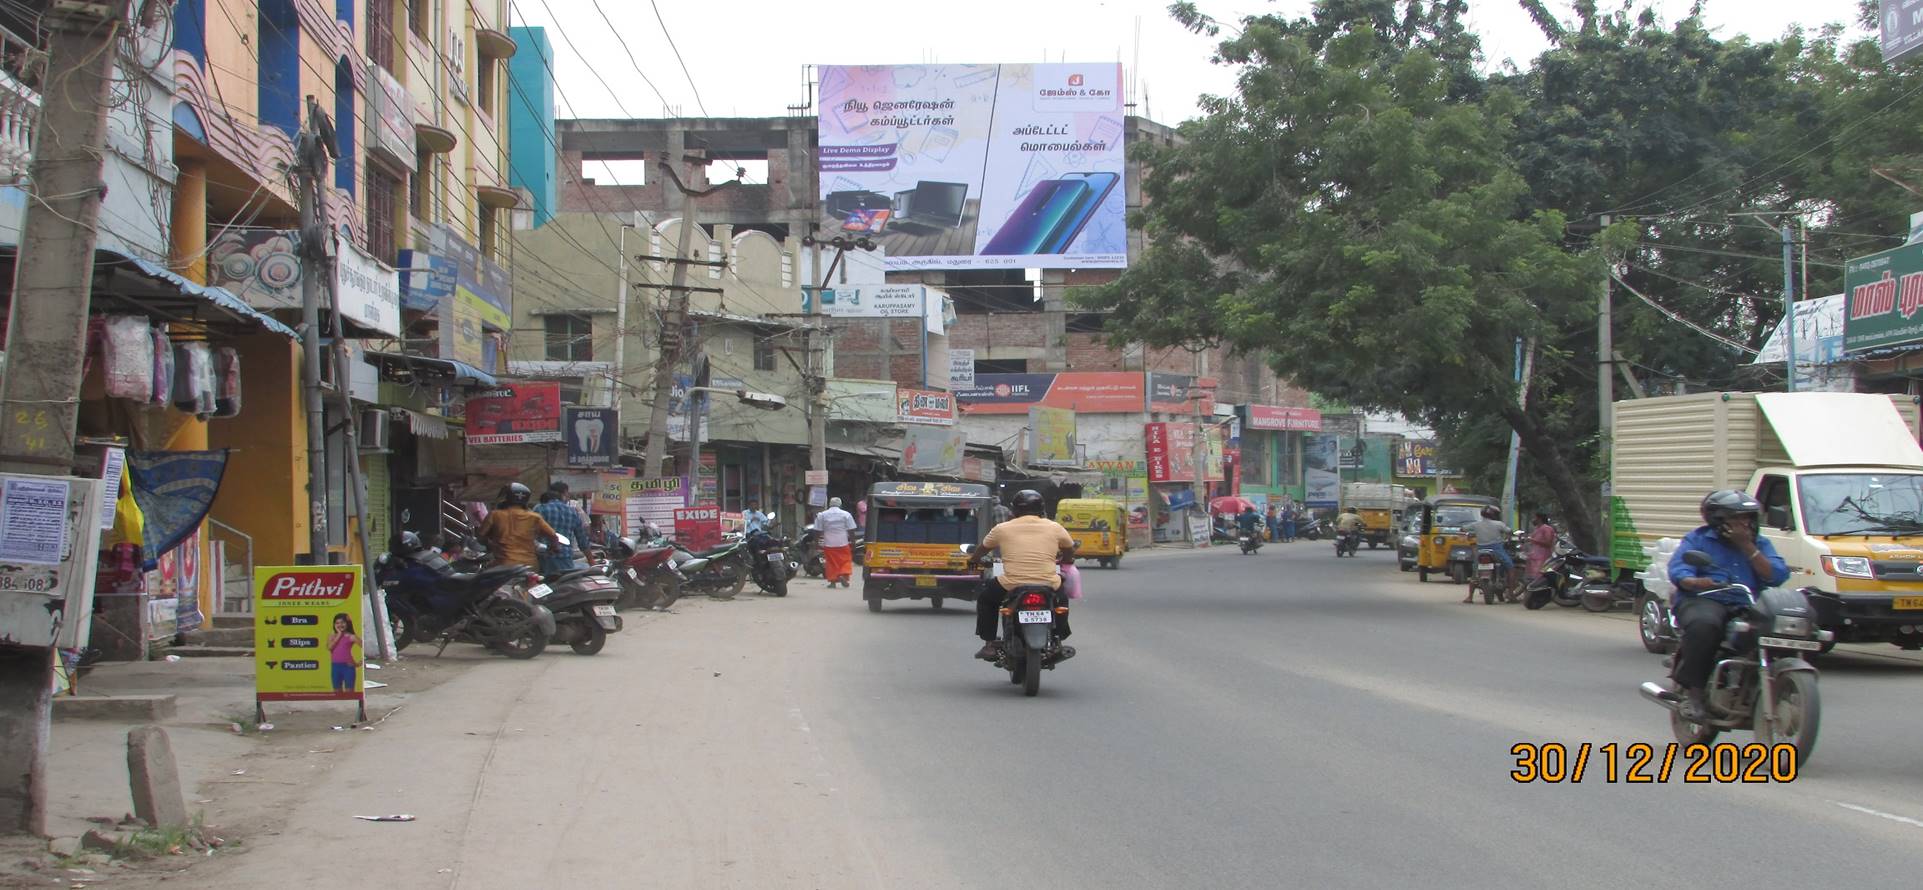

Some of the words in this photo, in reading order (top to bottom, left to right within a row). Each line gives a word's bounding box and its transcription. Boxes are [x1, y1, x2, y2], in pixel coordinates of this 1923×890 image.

[1039, 88, 1077, 97] ஜேம்ஸ்
[1079, 89, 1087, 97] &
[1089, 89, 1111, 97] கோ
[843, 99, 869, 113] நியூ
[872, 98, 955, 112] ஜெனரேஷன்
[870, 115, 955, 129] கம்ப்யூட்டர்கள்
[1012, 124, 1069, 136] அப்டேட்டட்
[862, 146, 890, 154] Display
[1020, 140, 1106, 152] மொபைல்கள்
[671, 385, 684, 398] Jio
[1011, 384, 1030, 393] IIFL
[483, 434, 524, 443] BATTERIES
[676, 509, 718, 520] EXIDE
[271, 577, 345, 596] Prithvi
[289, 639, 311, 648] Slips
